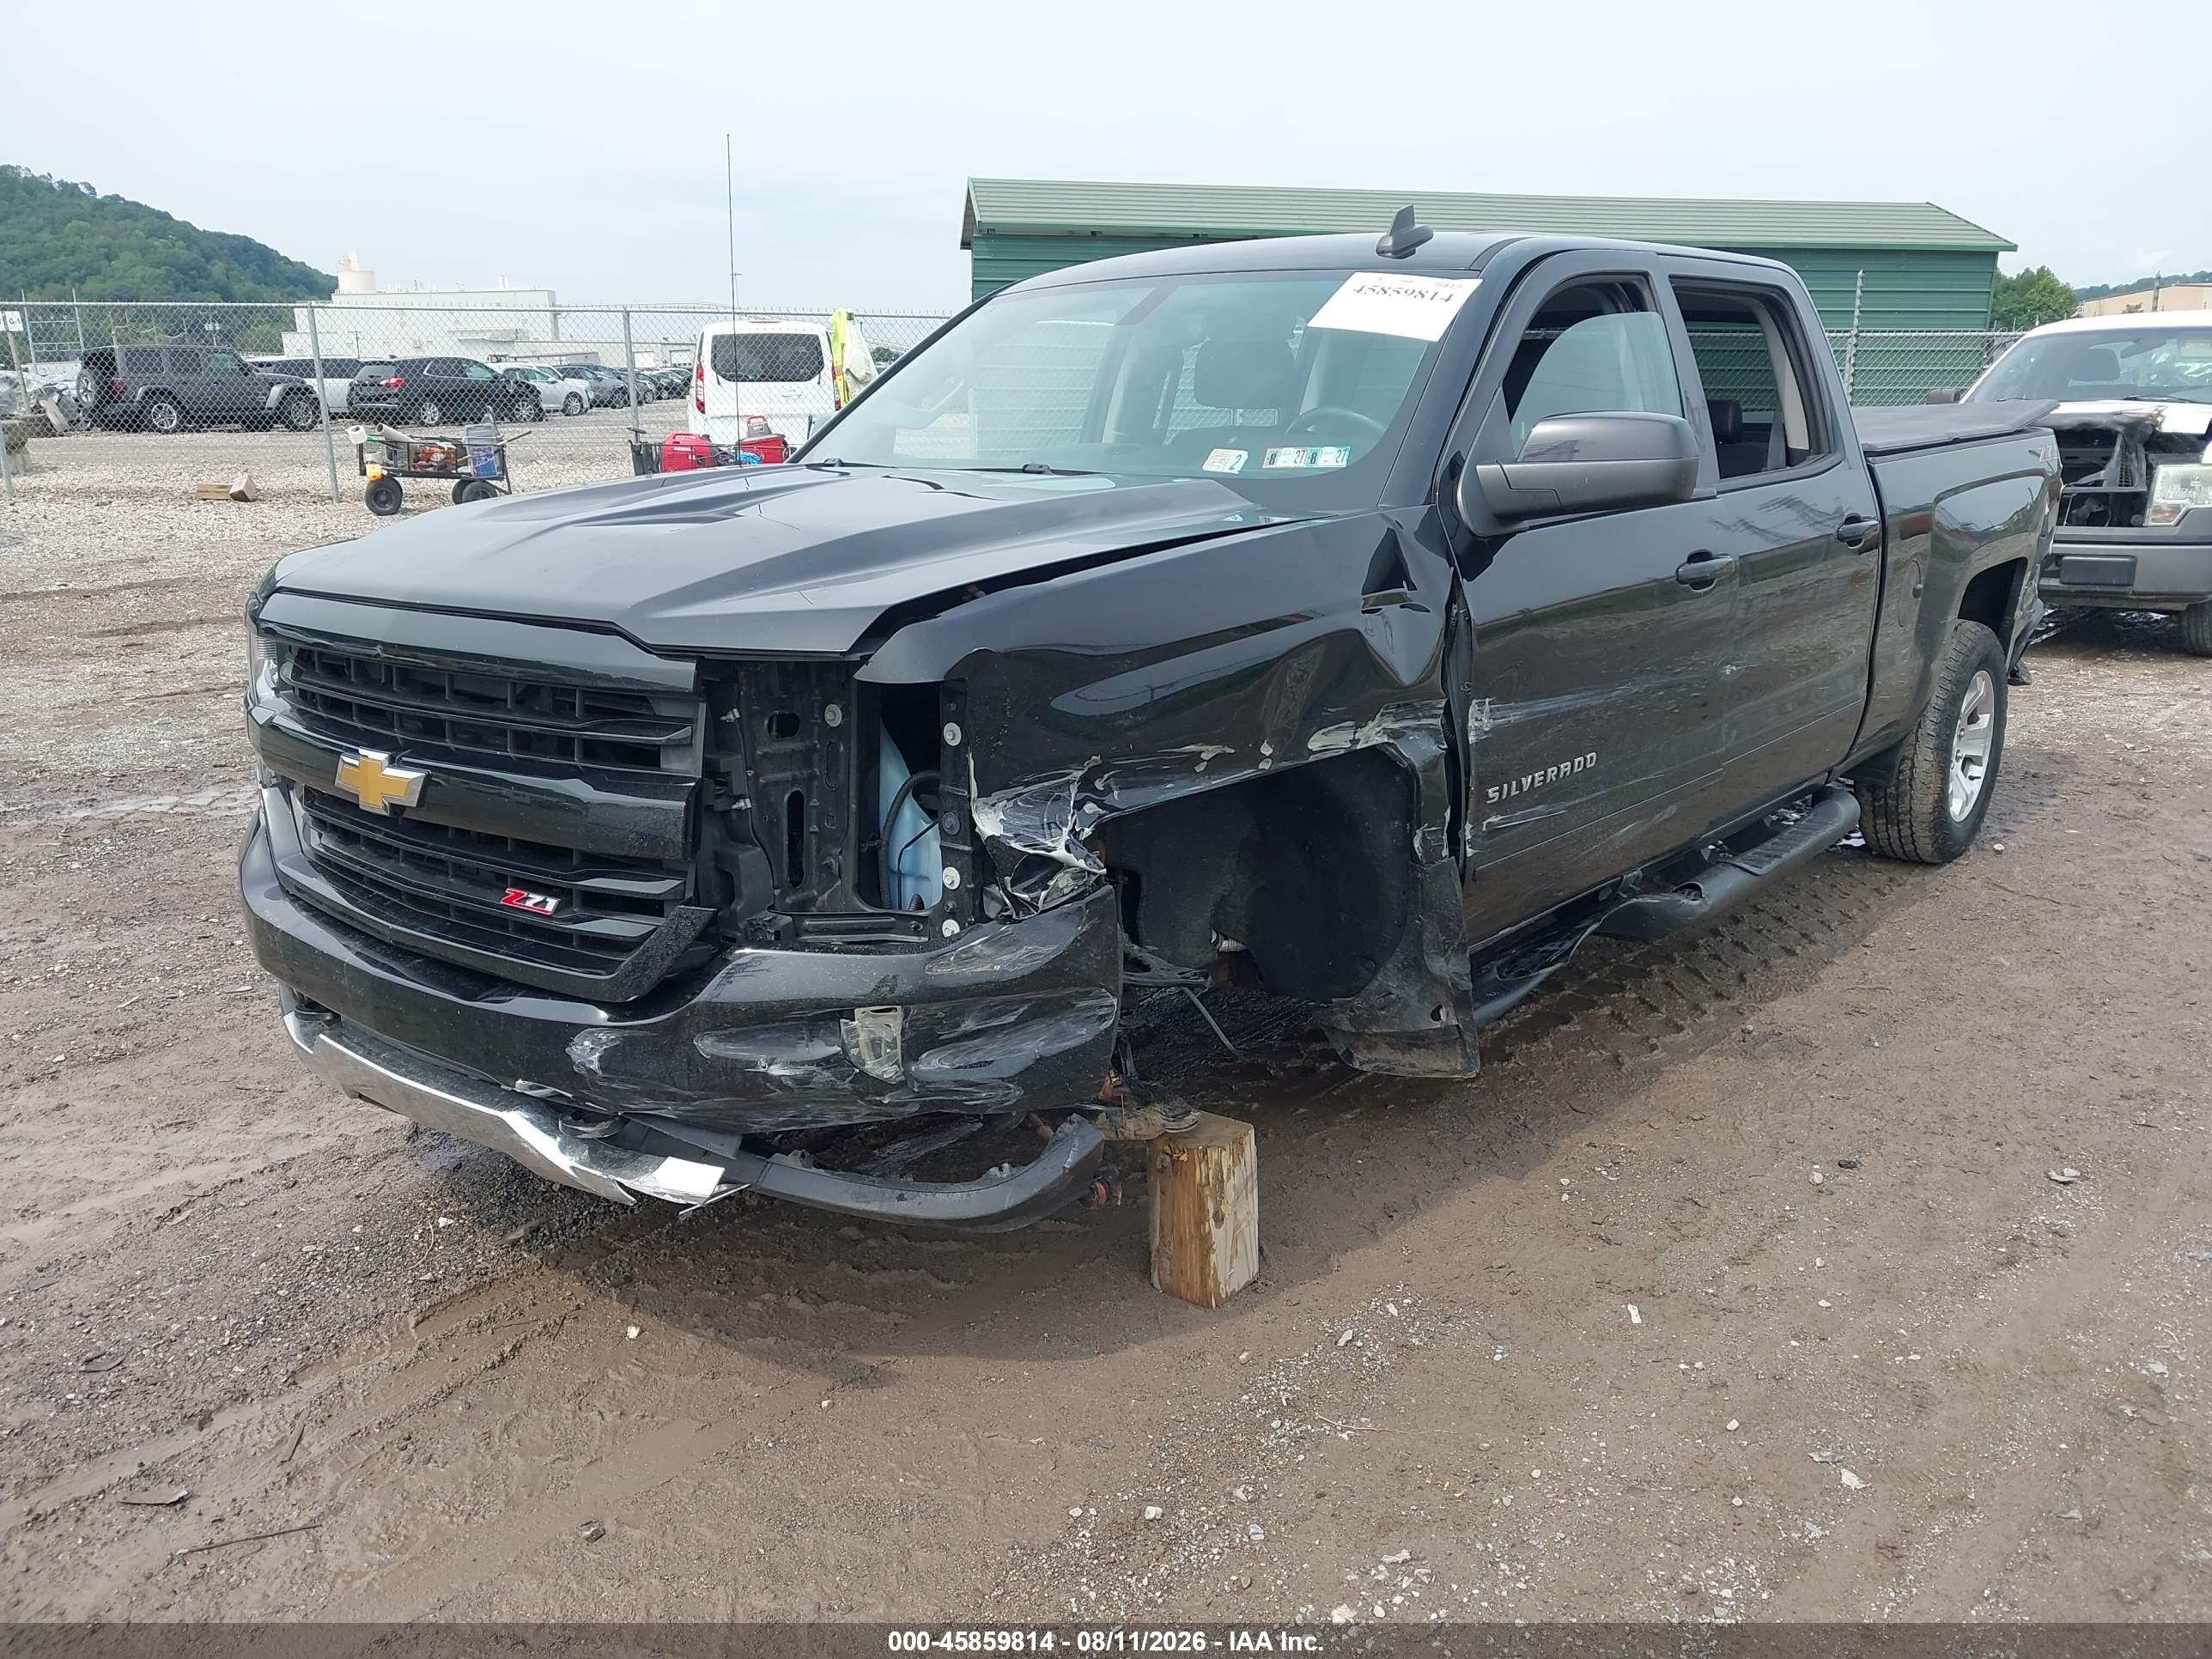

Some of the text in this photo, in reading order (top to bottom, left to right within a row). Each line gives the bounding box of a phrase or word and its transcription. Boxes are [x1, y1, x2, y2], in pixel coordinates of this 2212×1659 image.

[1352, 284, 1455, 303] 45859814
[1229, 454, 1243, 471] 2
[1293, 449, 1306, 465] 27
[1335, 448, 1347, 464] 27
[1486, 751, 1598, 805] SILVERADO
[500, 887, 561, 916] Z71
